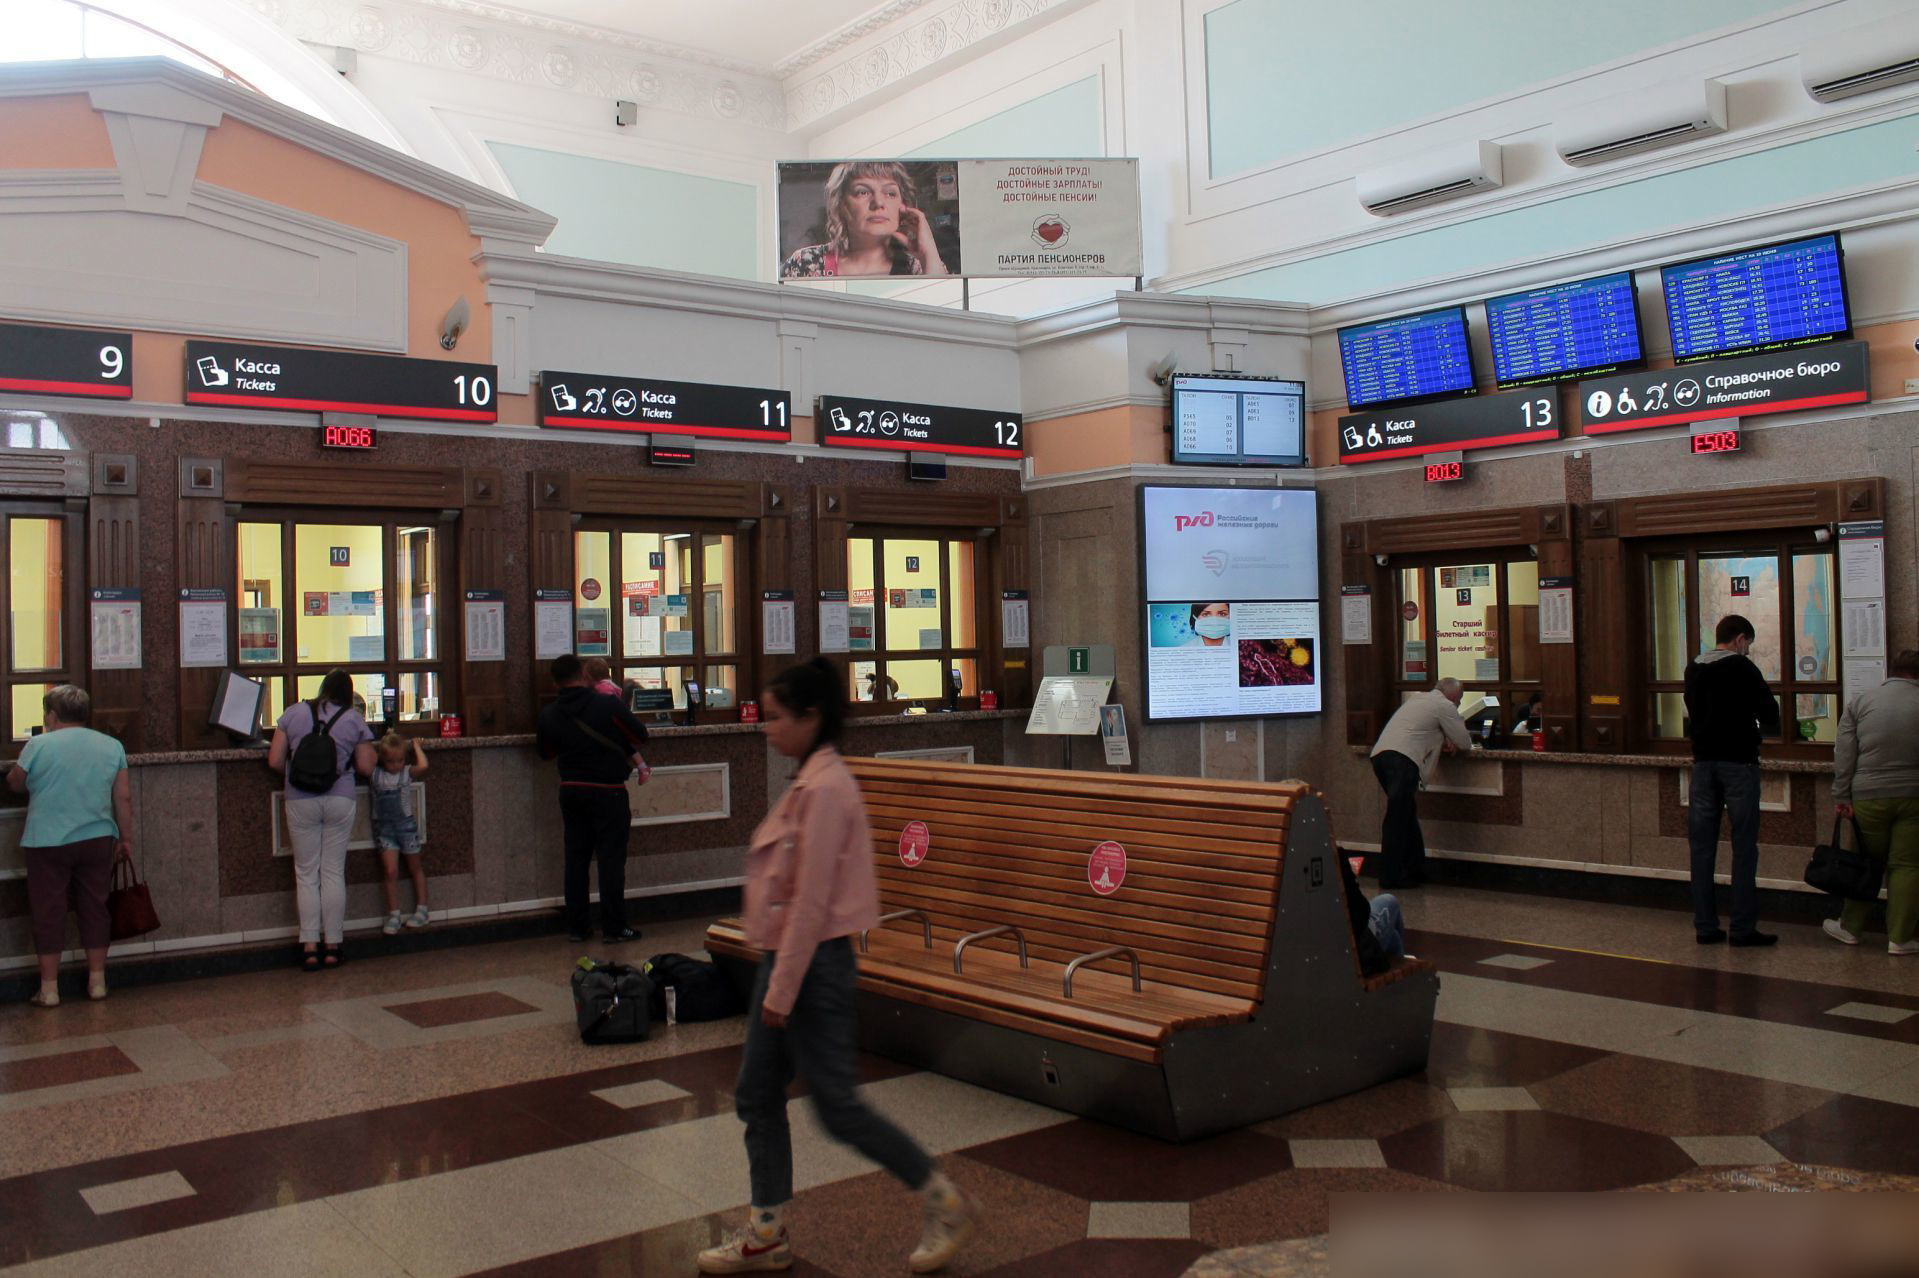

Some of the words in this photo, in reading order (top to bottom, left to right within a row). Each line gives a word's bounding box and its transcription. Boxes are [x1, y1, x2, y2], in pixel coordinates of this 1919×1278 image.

[1008, 165, 1063, 177] ДОСТОЙНЫЙ
[1066, 167, 1090, 177] ТРУД!
[997, 178, 1051, 190] ДОСТОЙНЫЕ
[1053, 180, 1102, 189] ЗАРПЛАТЫ!
[1003, 191, 1057, 203] ДОСТОЙНЫЕ
[1060, 193, 1097, 201] ПЕНСИИ!
[998, 255, 1034, 264] ПАРТИЯ
[1038, 254, 1104, 263] ПЕНСИОНЕРОВ
[99, 346, 123, 379] 9
[235, 358, 280, 375] Касса
[1705, 368, 1794, 391] Справочное
[1796, 359, 1841, 378] бюро
[236, 378, 276, 391] Tickets
[453, 375, 490, 405] 10
[641, 391, 676, 405] Касса
[1706, 387, 1771, 403] Information
[642, 407, 672, 419] Tickets
[760, 401, 786, 427] 11
[903, 413, 931, 425] Касса
[1520, 400, 1552, 427] 13
[1385, 418, 1416, 432] Касса
[903, 428, 928, 438] Tickets
[994, 422, 1018, 446] 12
[1387, 434, 1413, 444] Tickets
[332, 549, 347, 562] 10
[651, 554, 662, 566] 11
[908, 559, 917, 569] 12
[1733, 579, 1747, 591] 14
[1458, 591, 1469, 601] 13
[1453, 619, 1482, 629] Старший
